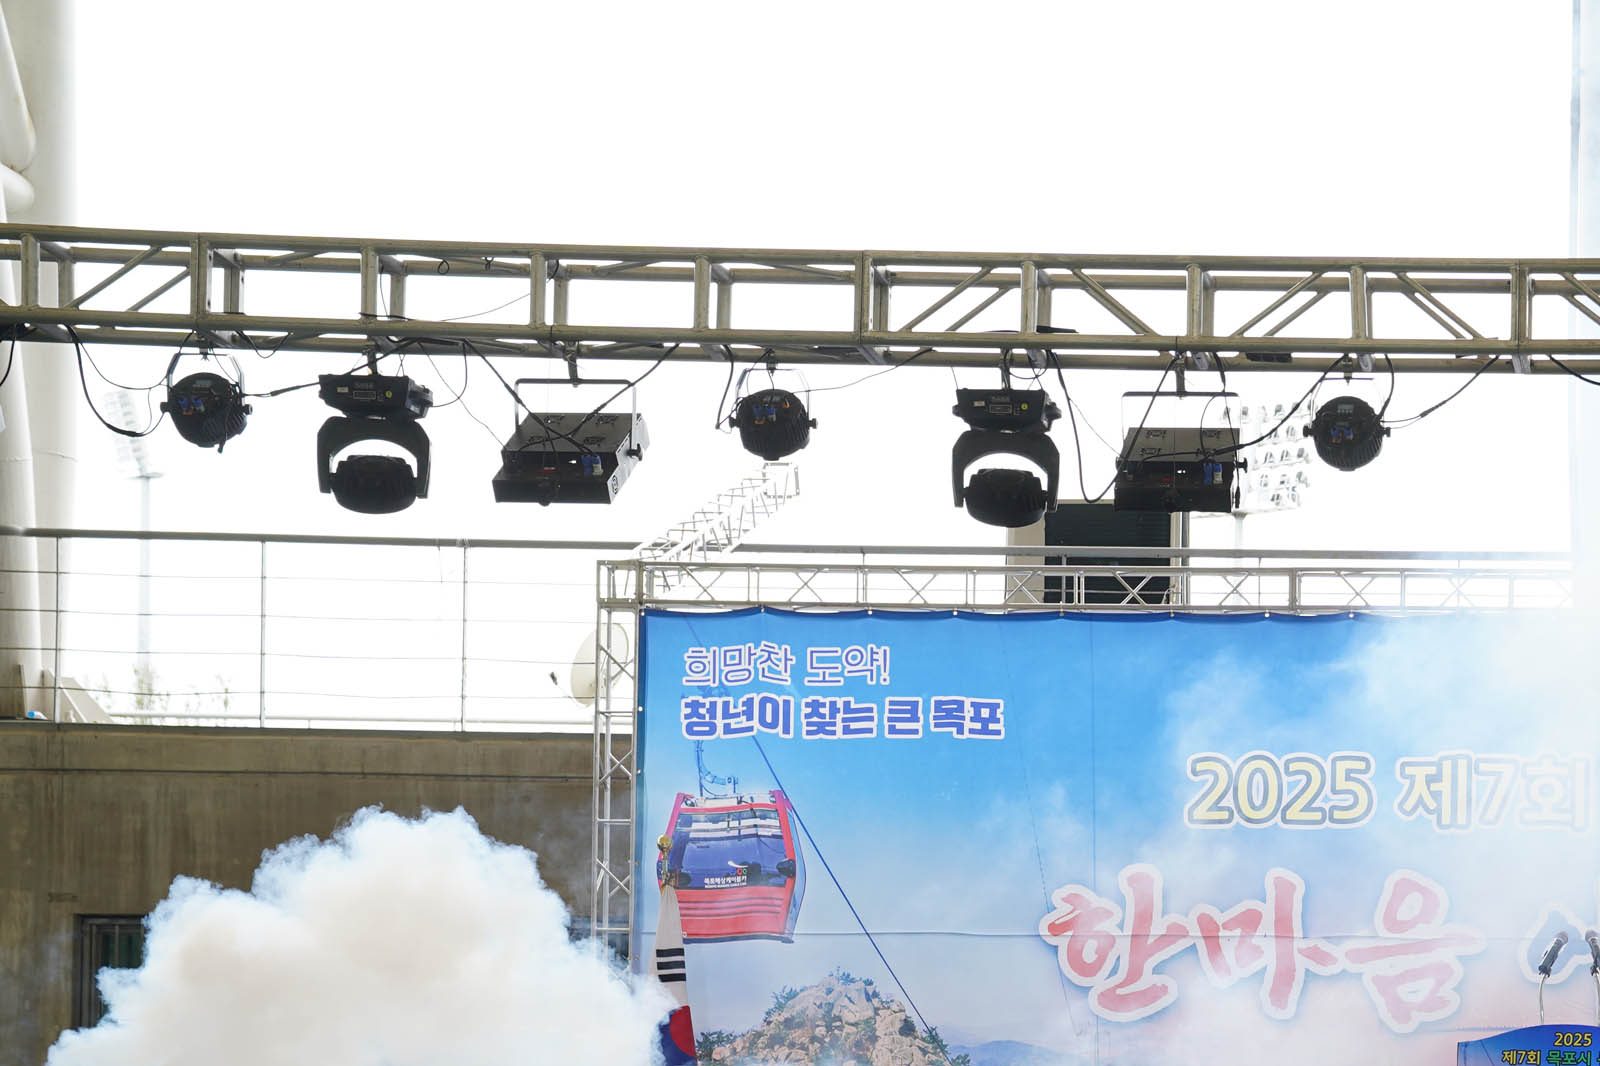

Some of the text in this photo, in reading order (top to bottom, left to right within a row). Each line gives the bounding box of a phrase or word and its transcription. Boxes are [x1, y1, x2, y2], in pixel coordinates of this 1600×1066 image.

[683, 641, 890, 686] 희망찬 도약!
[681, 693, 1005, 739] 청년이 찾는 큰 목포
[1184, 750, 1375, 829] 2025
[1395, 752, 1592, 832] 제7회
[1038, 863, 1487, 1033] 한마음
[1502, 1049, 1542, 1066] 제7회
[1546, 1050, 1592, 1066] 목포시
[1553, 1032, 1593, 1048] 2025
